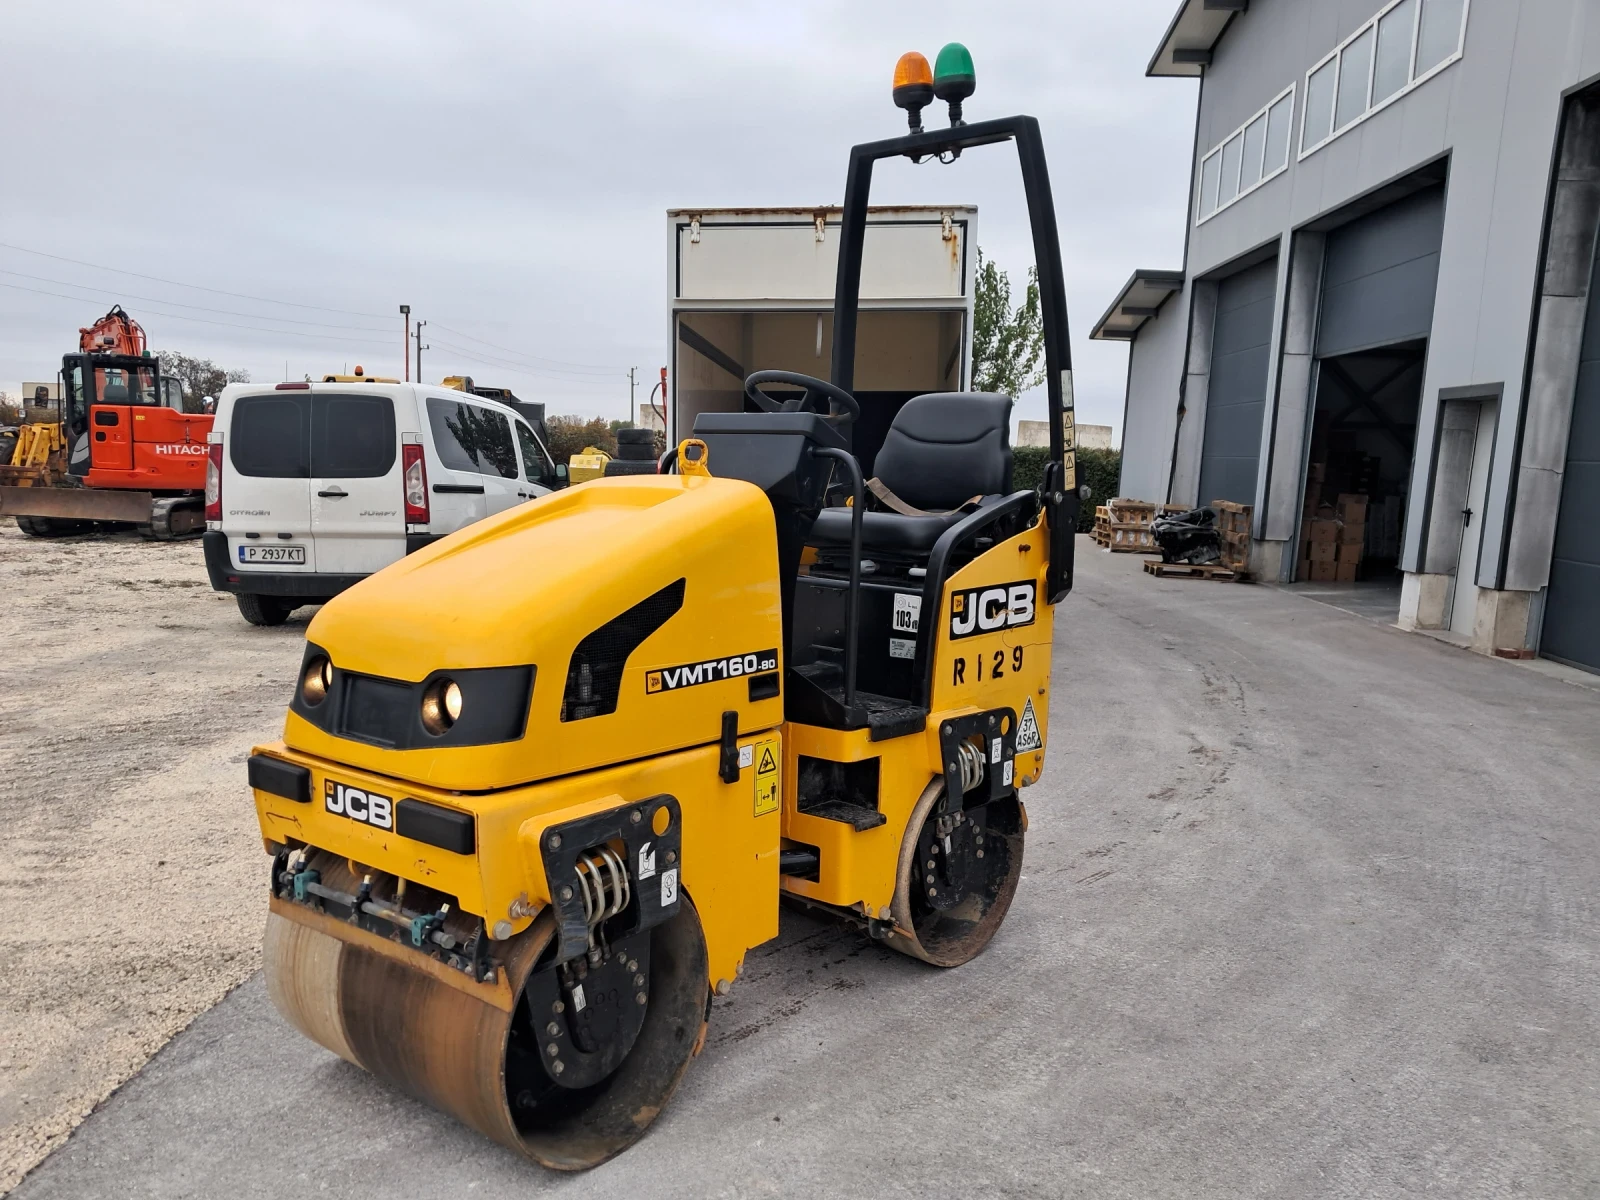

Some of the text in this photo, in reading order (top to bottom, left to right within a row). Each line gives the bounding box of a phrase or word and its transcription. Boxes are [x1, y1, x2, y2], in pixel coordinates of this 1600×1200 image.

[155, 444, 210, 455] HITACH
[249, 548, 257, 560] P
[952, 584, 1035, 635] JCB
[895, 609, 912, 629] 103
[1022, 717, 1033, 733] 37
[326, 784, 393, 829] JCB
